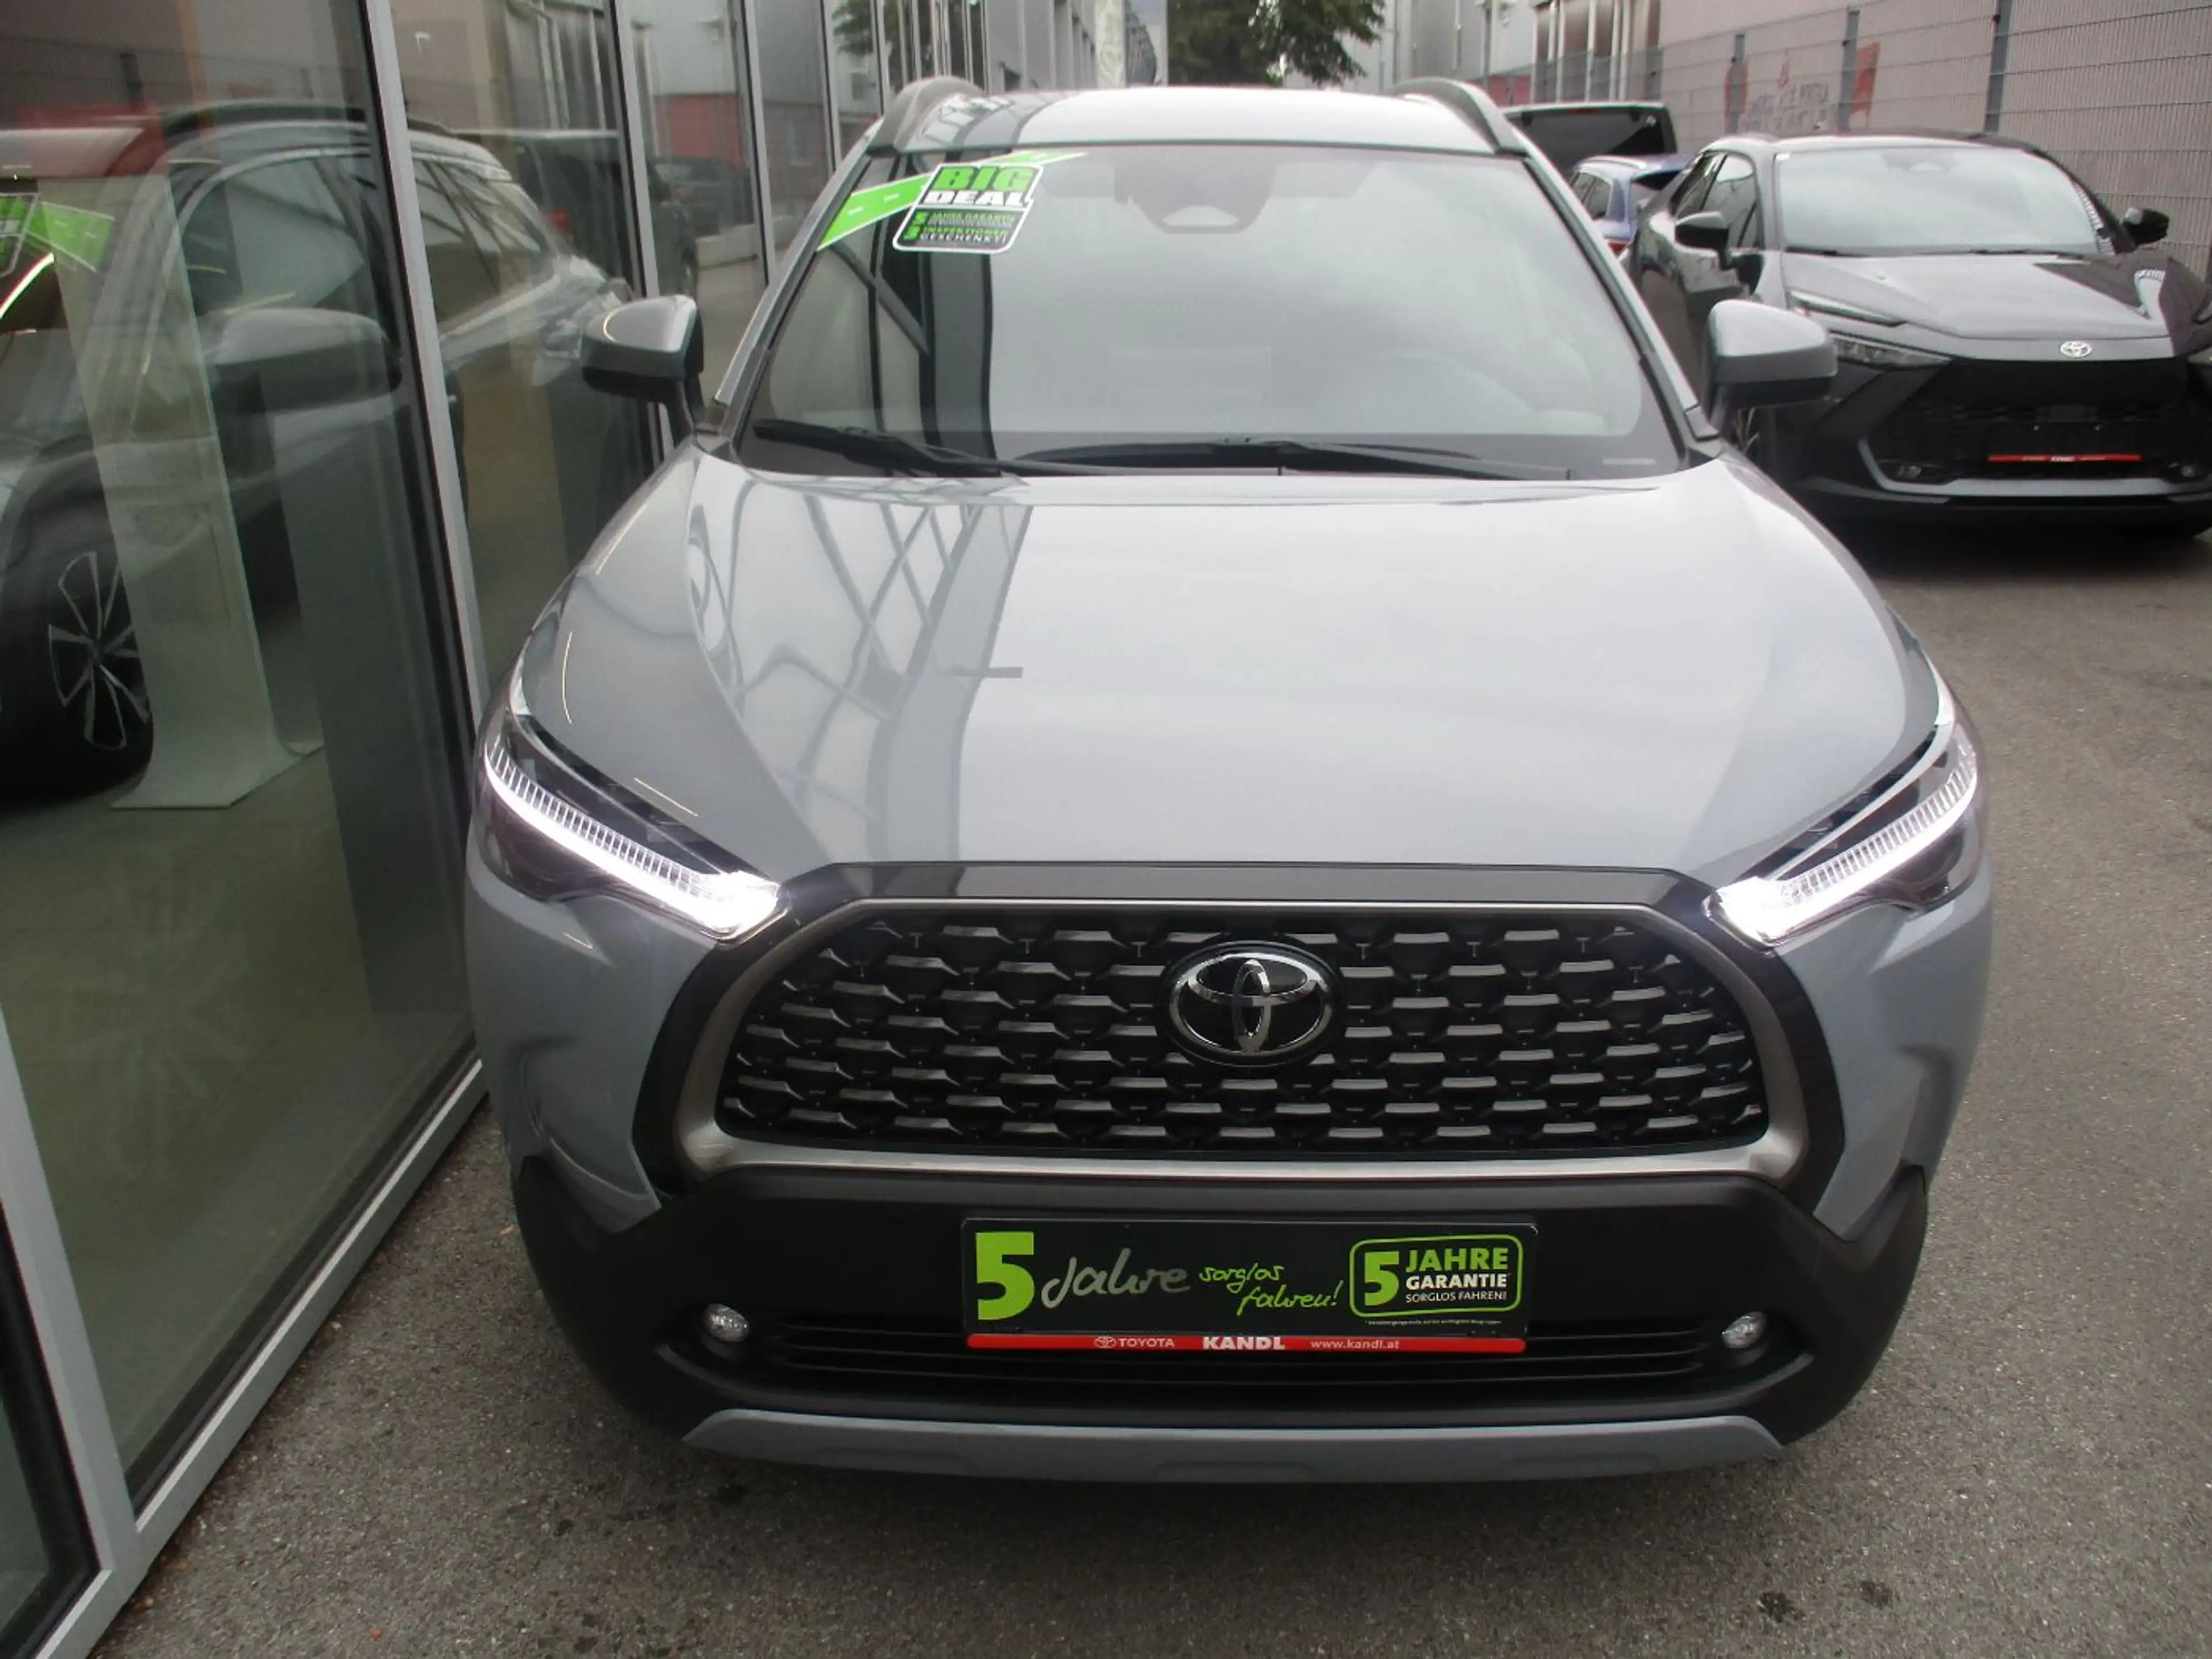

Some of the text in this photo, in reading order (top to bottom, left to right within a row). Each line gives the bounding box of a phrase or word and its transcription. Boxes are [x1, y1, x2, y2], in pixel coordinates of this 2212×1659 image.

[933, 166, 1035, 191] BIG
[923, 191, 1024, 207] DEAL
[976, 1232, 1285, 1320] 5 Jahre sorglos
[1364, 1247, 1509, 1307] 5 JAHRE
[1406, 1273, 1508, 1290] GARANTIE
[1237, 1280, 1344, 1316] fahren!
[1406, 1290, 1508, 1303] SORGLOS FAHREN!
[1118, 1336, 1400, 1351] TOYOTA KANDL www.kandl.at
